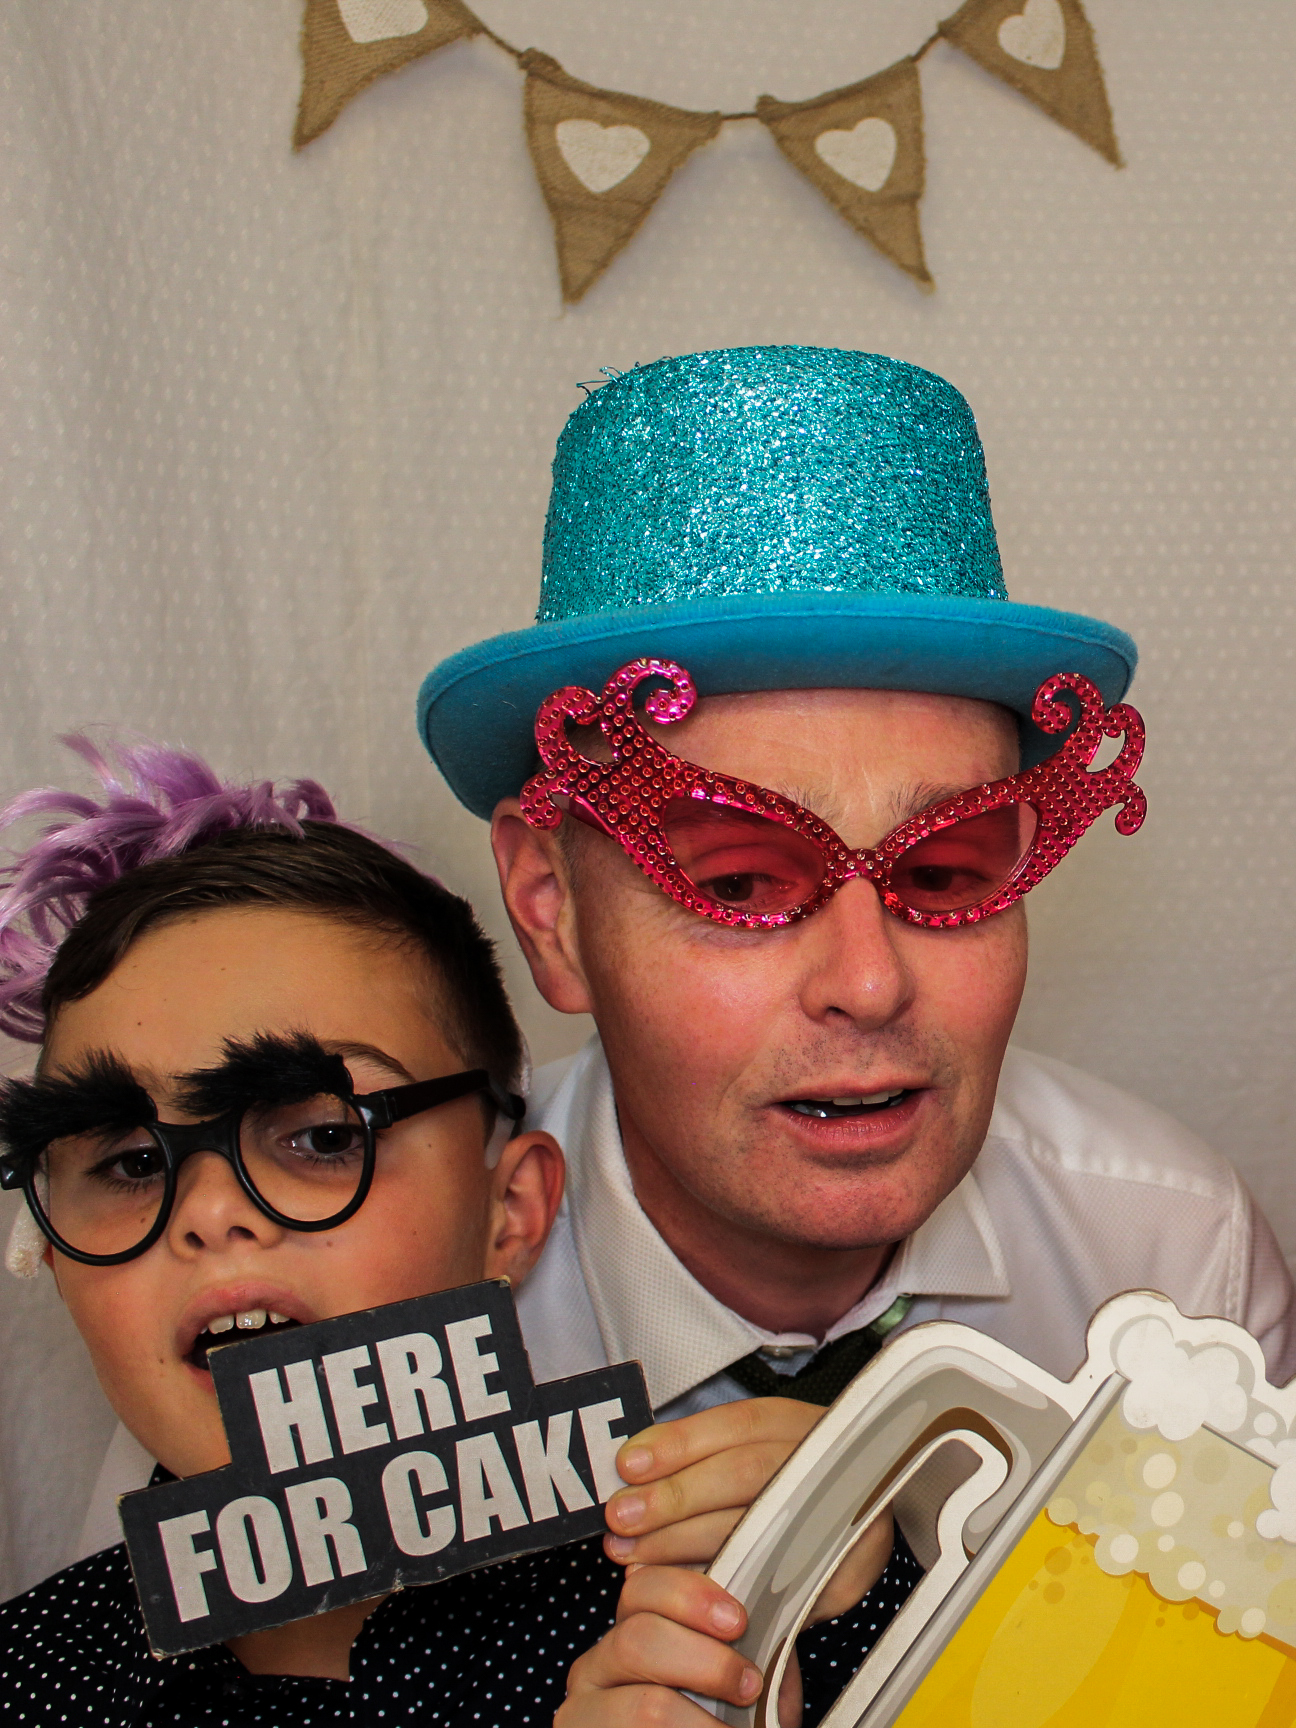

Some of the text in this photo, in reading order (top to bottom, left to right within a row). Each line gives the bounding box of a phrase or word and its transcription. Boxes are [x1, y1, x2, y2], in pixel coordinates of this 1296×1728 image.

[249, 1314, 511, 1474] HERE
[158, 1398, 630, 1622] FOR CAKE
